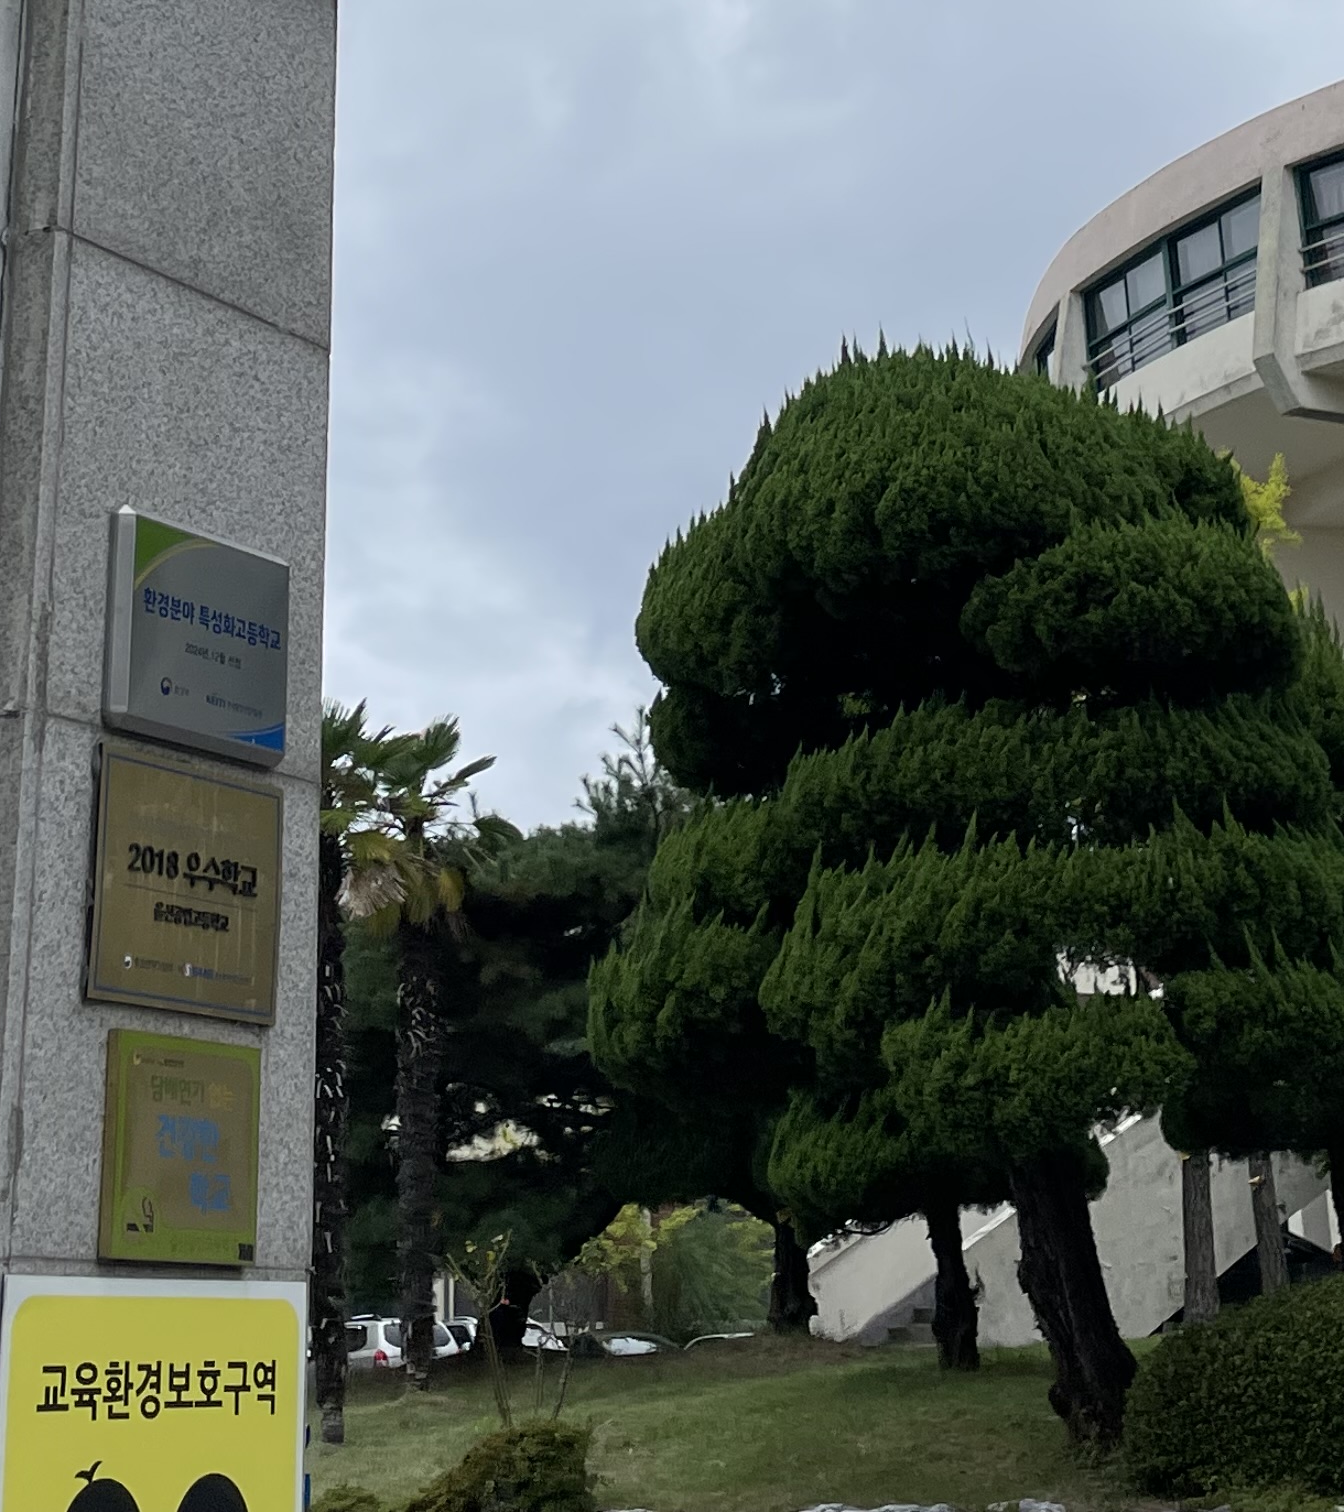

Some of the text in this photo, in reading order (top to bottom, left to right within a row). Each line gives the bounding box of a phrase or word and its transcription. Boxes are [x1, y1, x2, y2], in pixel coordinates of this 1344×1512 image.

[143, 587, 282, 651] 환경분야 특성화고등학교
[127, 842, 258, 898] 2018 우수학교
[36, 1359, 277, 1422] 교육환경보호구역
